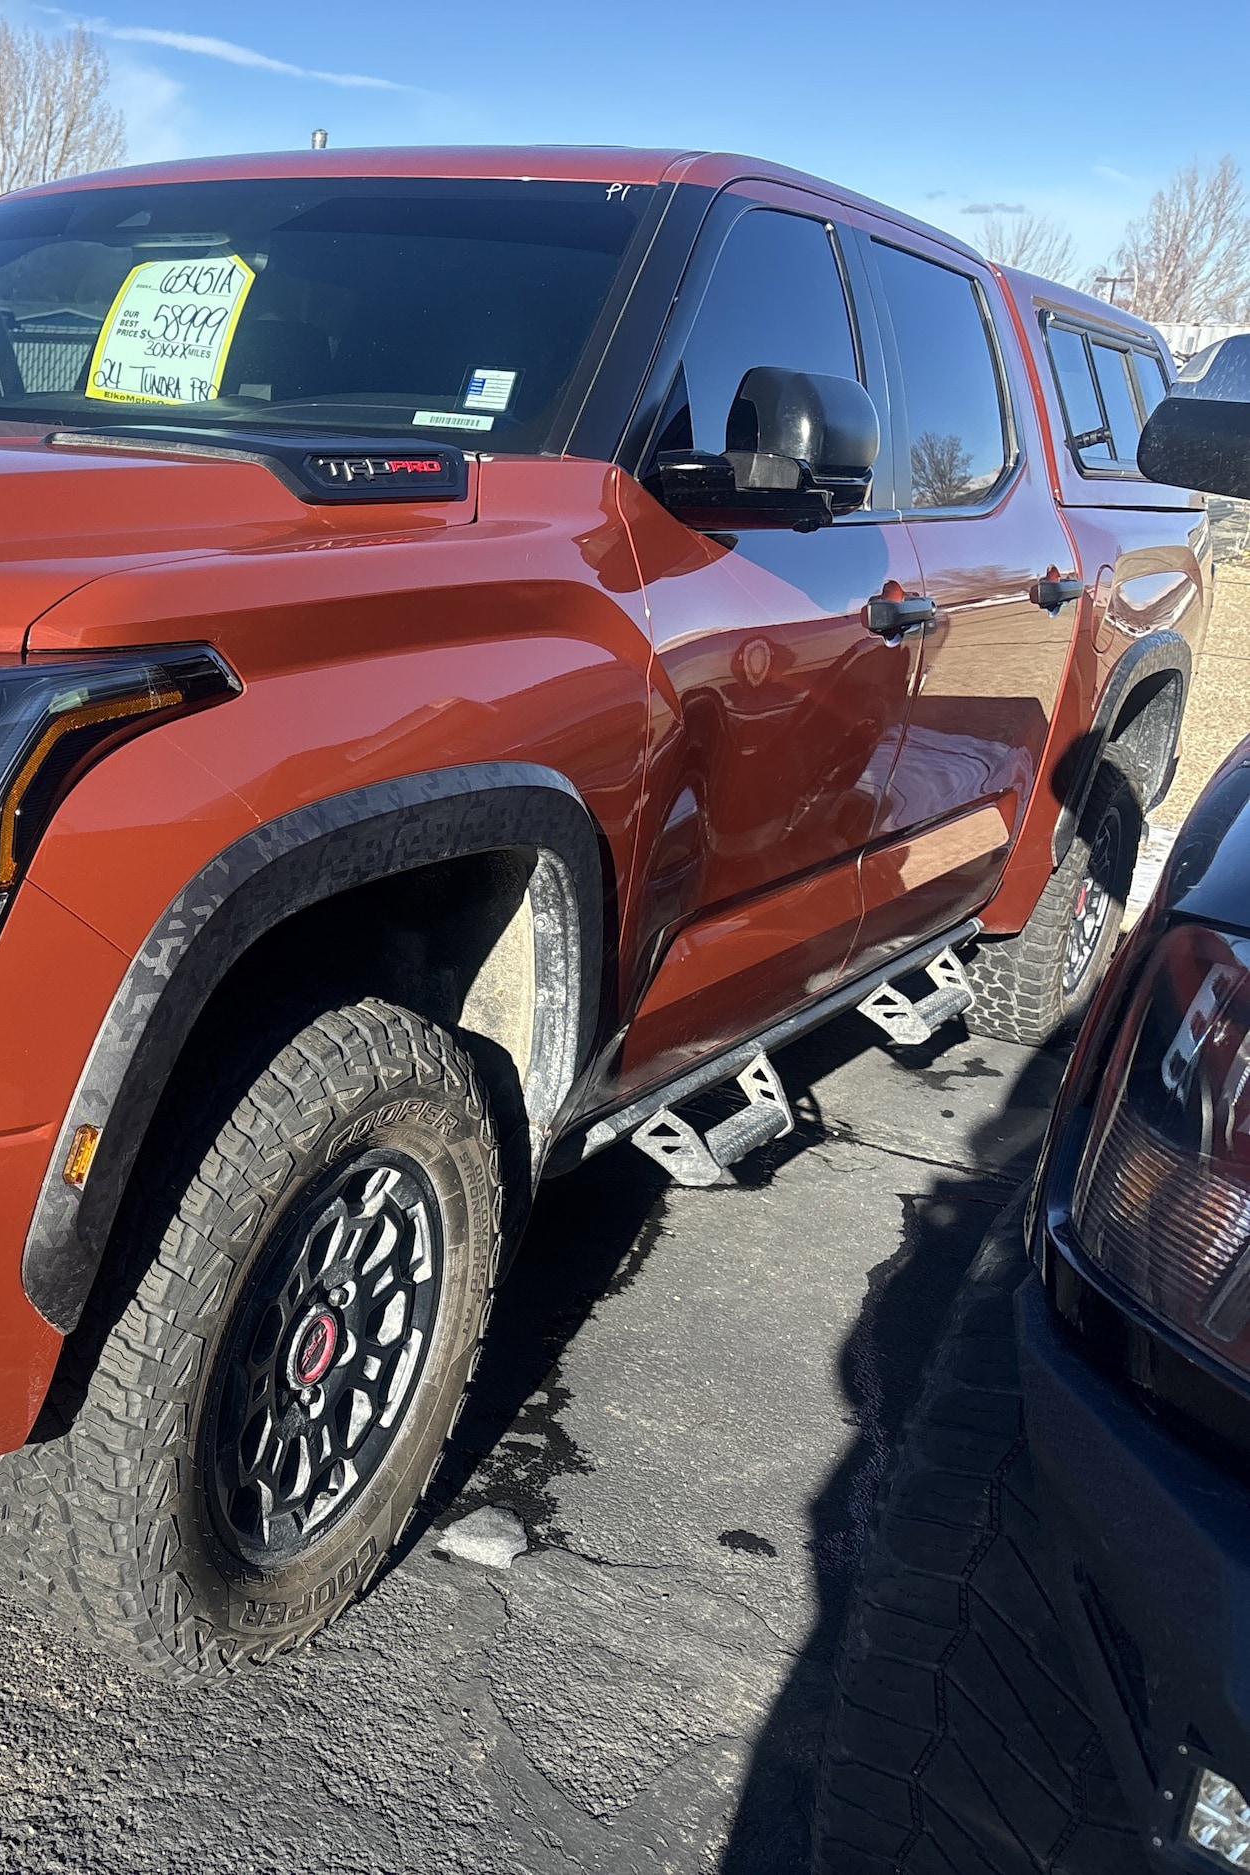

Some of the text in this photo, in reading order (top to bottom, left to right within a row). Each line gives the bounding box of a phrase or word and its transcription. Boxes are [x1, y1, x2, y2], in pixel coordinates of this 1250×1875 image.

[159, 264, 237, 295] 65451A
[119, 319, 139, 328] BEST
[123, 310, 139, 318] OUR
[116, 328, 139, 338] PRICE
[188, 347, 211, 359] MILES
[128, 365, 182, 400] TUNDRA
[318, 459, 441, 481] TRD PRO
[326, 1098, 459, 1163] COOPER
[458, 1150, 482, 1294] STRONGHOLD
[474, 1163, 490, 1304] DISCOVERER
[239, 1535, 378, 1630] COOPER
